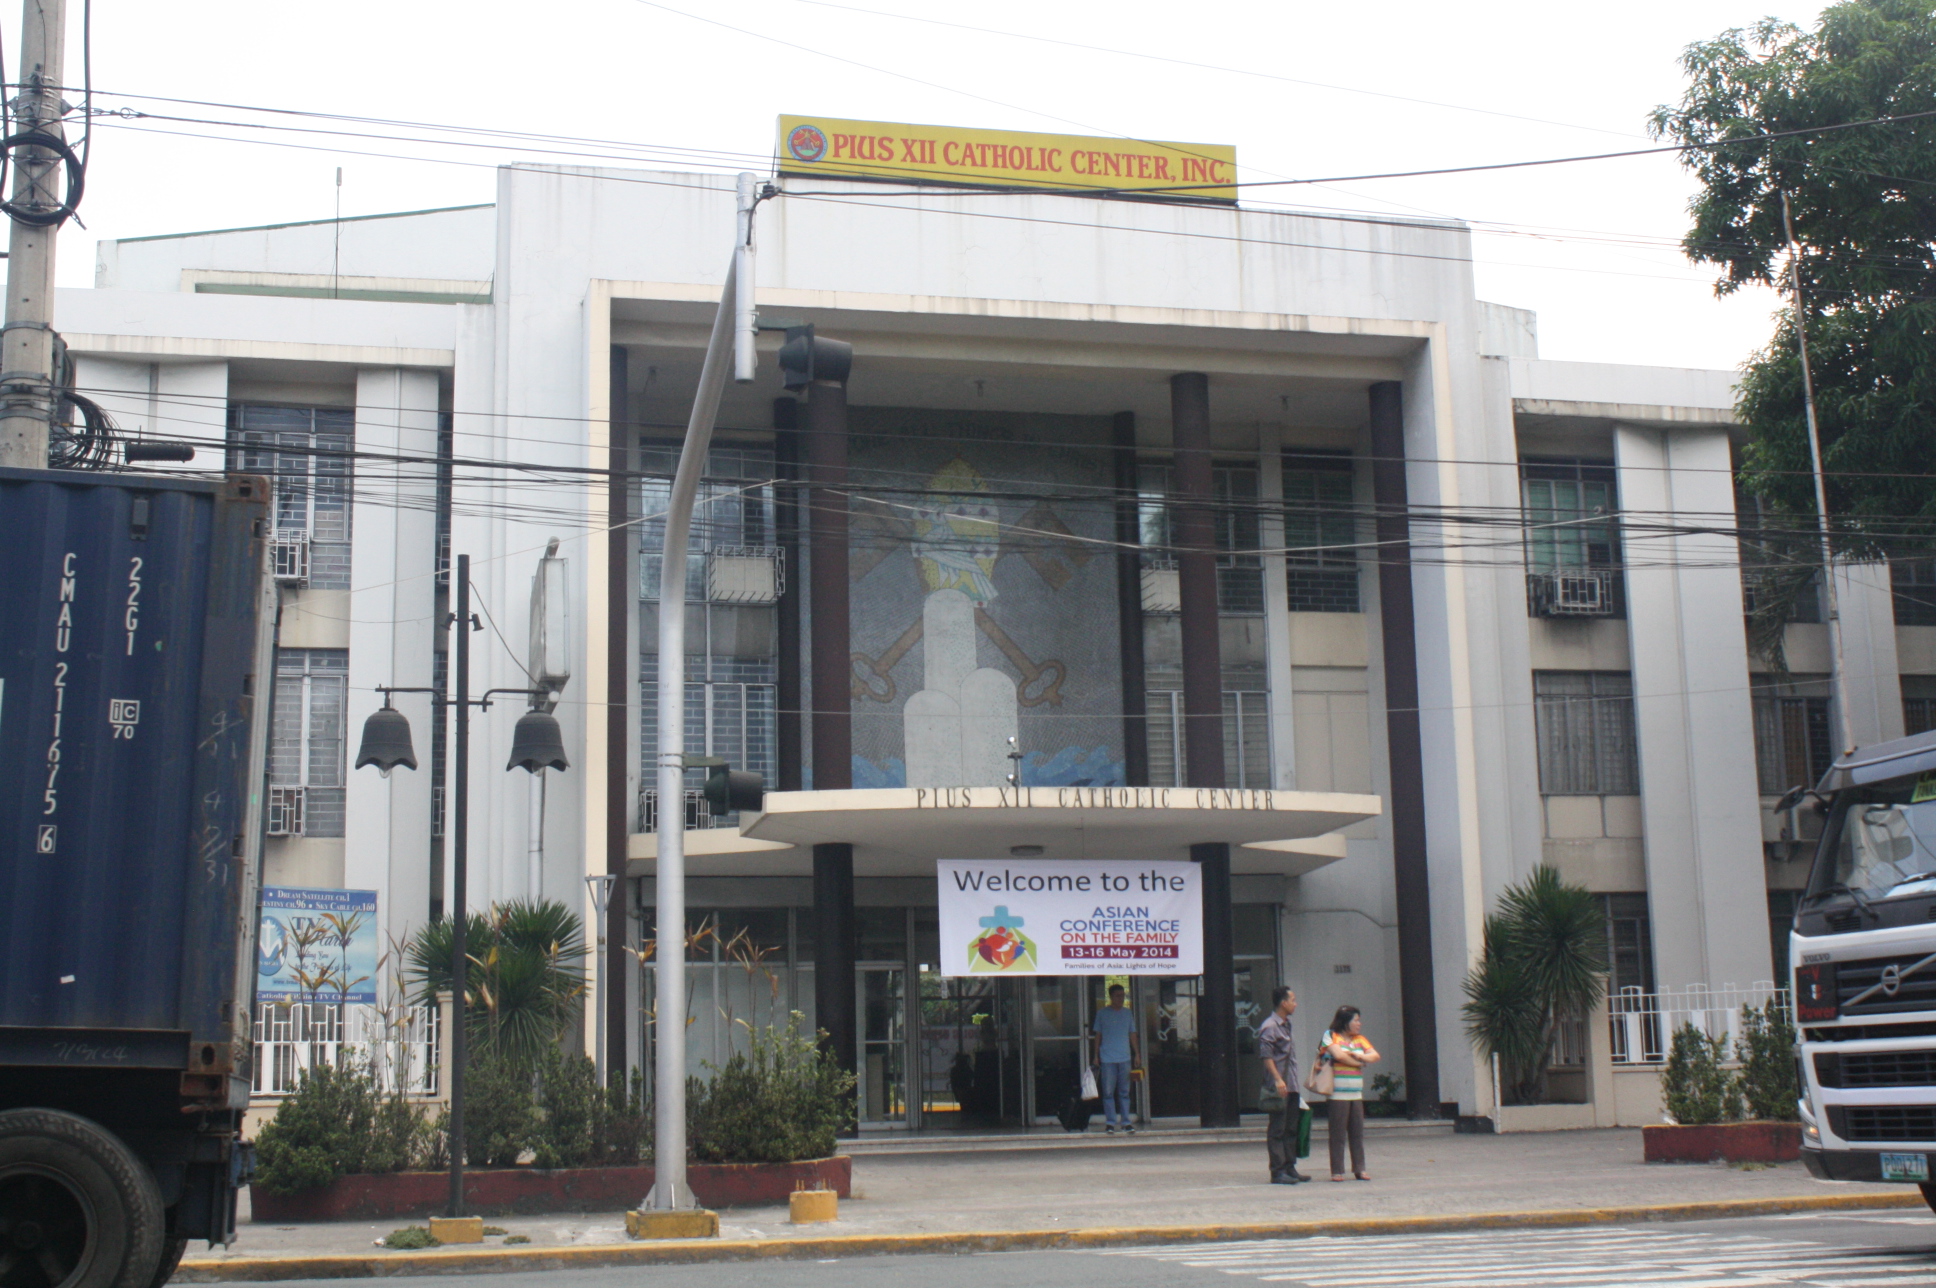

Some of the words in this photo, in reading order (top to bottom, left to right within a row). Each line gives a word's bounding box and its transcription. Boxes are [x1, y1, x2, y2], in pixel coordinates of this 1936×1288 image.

[832, 133, 894, 161] PIUS
[900, 138, 936, 165] XII
[942, 141, 1061, 172] CATHOLIC
[1070, 150, 1177, 182] CENTER,
[1182, 157, 1231, 184] INC.
[57, 553, 77, 652] CMAU
[126, 557, 143, 655] 22G1
[113, 725, 134, 739] 70
[916, 788, 972, 808] PIUS
[998, 787, 1033, 808] XII
[1058, 787, 1171, 809] CATHOLIC
[1196, 789, 1275, 811] CENTER
[40, 827, 54, 852] 6
[953, 870, 1091, 892] Welcome
[1101, 873, 1130, 892] to
[1139, 870, 1185, 892] the
[278, 890, 300, 899] DREAM
[302, 891, 334, 901] SATELLITE
[262, 900, 284, 909] ESTINY
[330, 902, 350, 912] CABLE
[1092, 906, 1149, 918] ASIAN
[292, 916, 321, 931] TV
[1060, 919, 1180, 932] CONFERENCE
[1061, 932, 1086, 943] ON
[1091, 932, 1121, 943] THE
[1126, 932, 1178, 943] FAMILY
[1069, 947, 1105, 957] 13-16
[1110, 947, 1136, 959] May
[1141, 947, 1172, 957] 2014
[1803, 953, 1830, 963] VOLVO
[1064, 962, 1095, 970] Families
[1097, 962, 1105, 970] of
[1126, 962, 1147, 971] Lights
[1148, 962, 1156, 970] of
[1158, 962, 1177, 971] Hope
